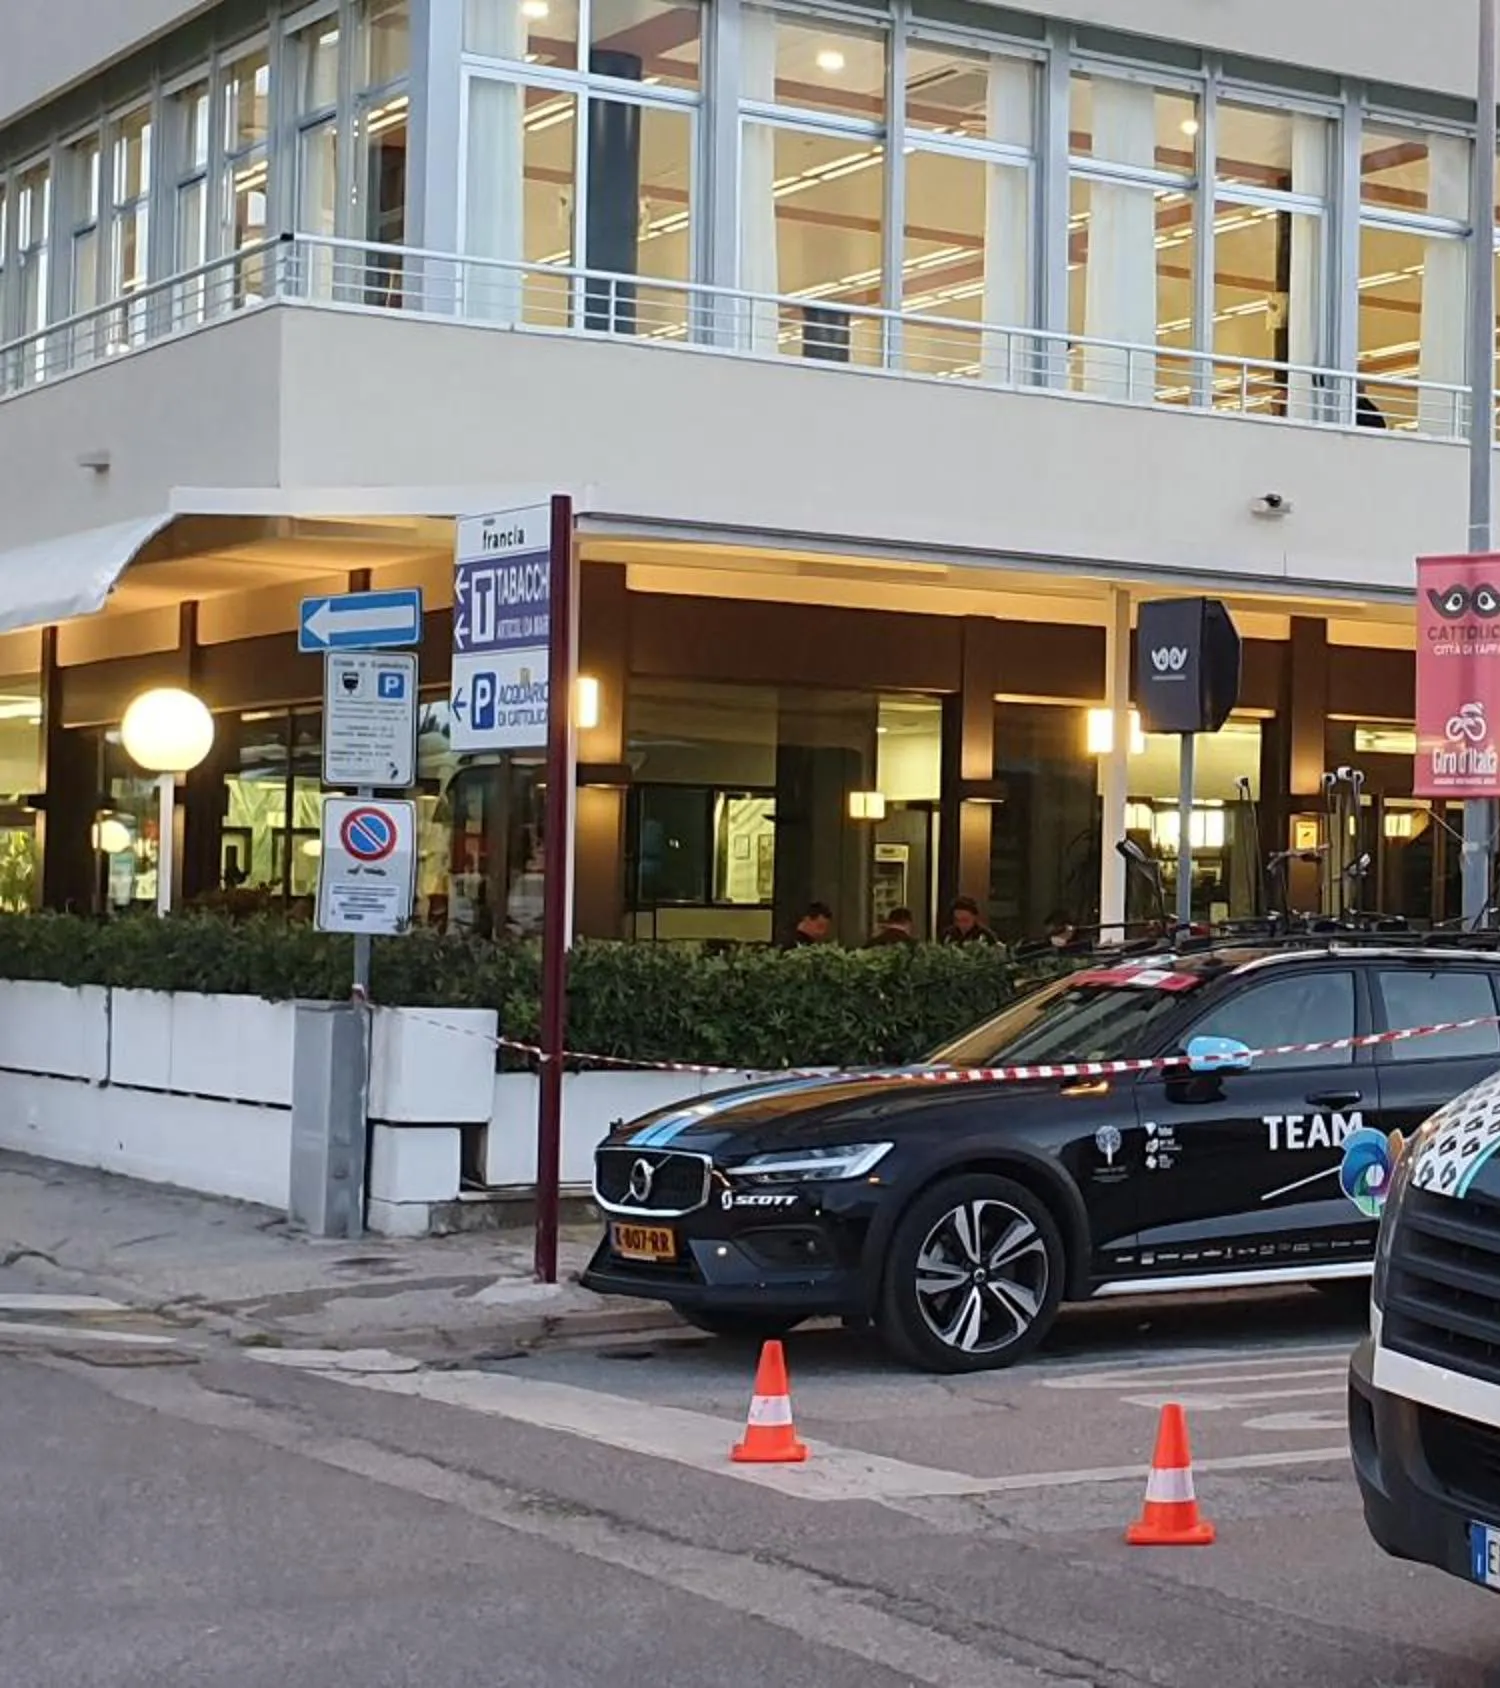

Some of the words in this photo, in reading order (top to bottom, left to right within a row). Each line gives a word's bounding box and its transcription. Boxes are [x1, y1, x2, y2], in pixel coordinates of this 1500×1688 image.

[482, 525, 525, 550] francia
[496, 562, 550, 605] TABACCH
[1263, 1111, 1363, 1151] TEAM
[734, 1195, 798, 1206] SCOTT
